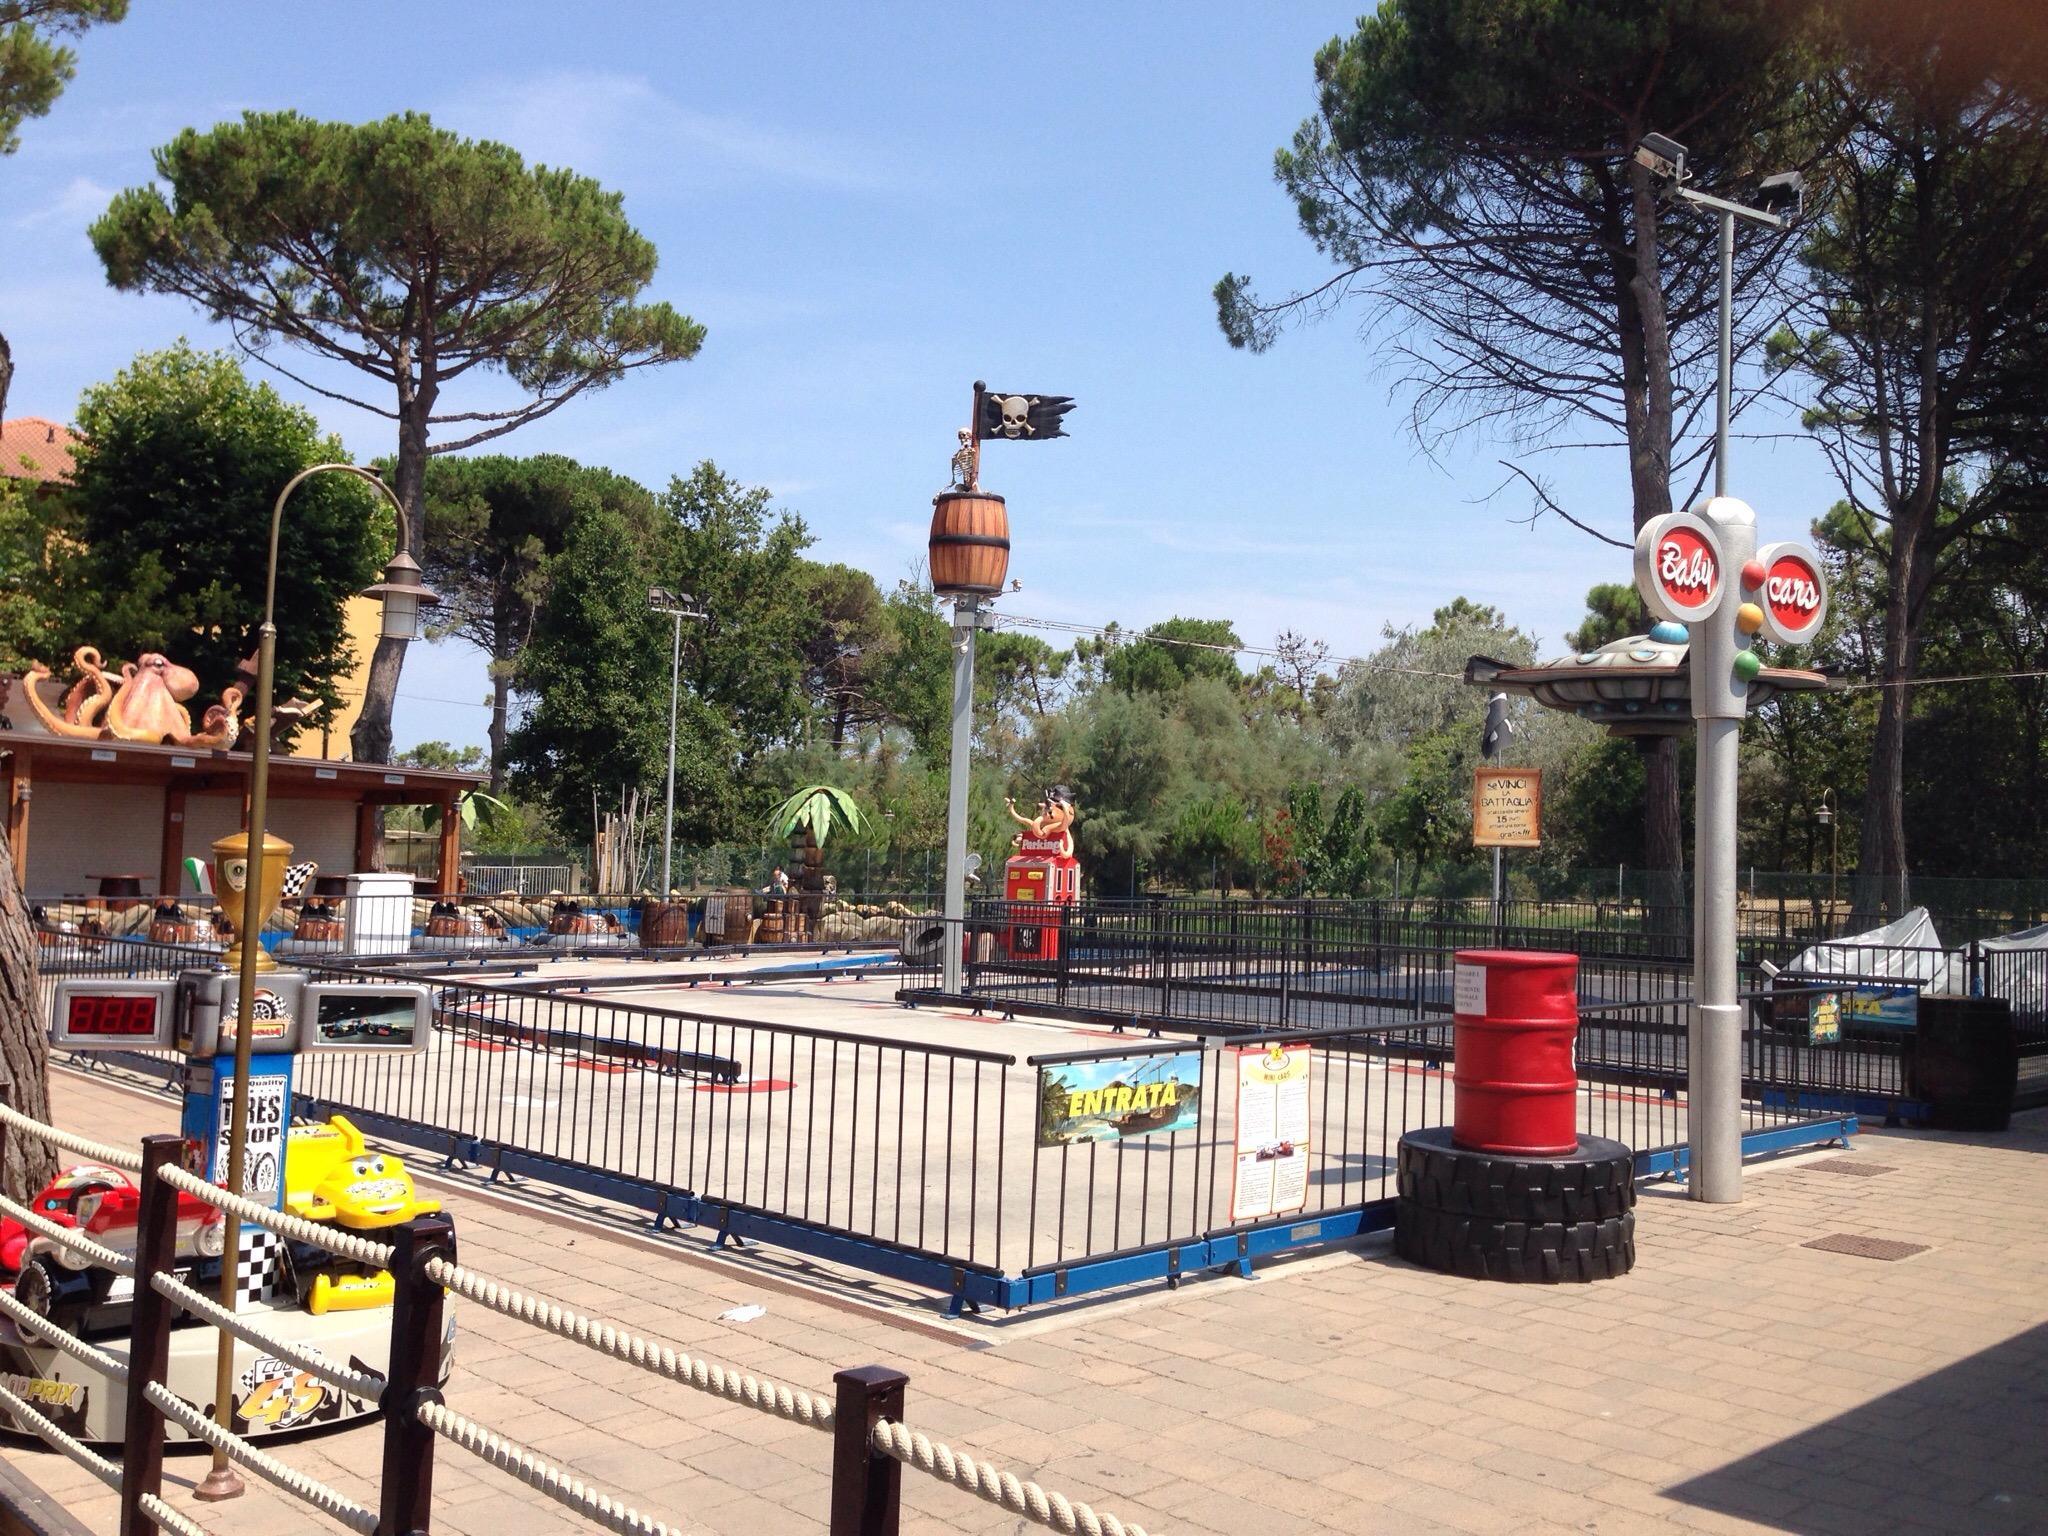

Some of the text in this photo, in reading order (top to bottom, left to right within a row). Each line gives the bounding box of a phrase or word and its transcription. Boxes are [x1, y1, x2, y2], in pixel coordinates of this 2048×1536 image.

[1662, 541, 1820, 610] Baby cars
[1497, 779, 1527, 789] VINCI
[1481, 797, 1533, 807] BATTAGLIA
[1022, 838, 1061, 854] Parking
[1068, 1081, 1177, 1118] ENTRATA
